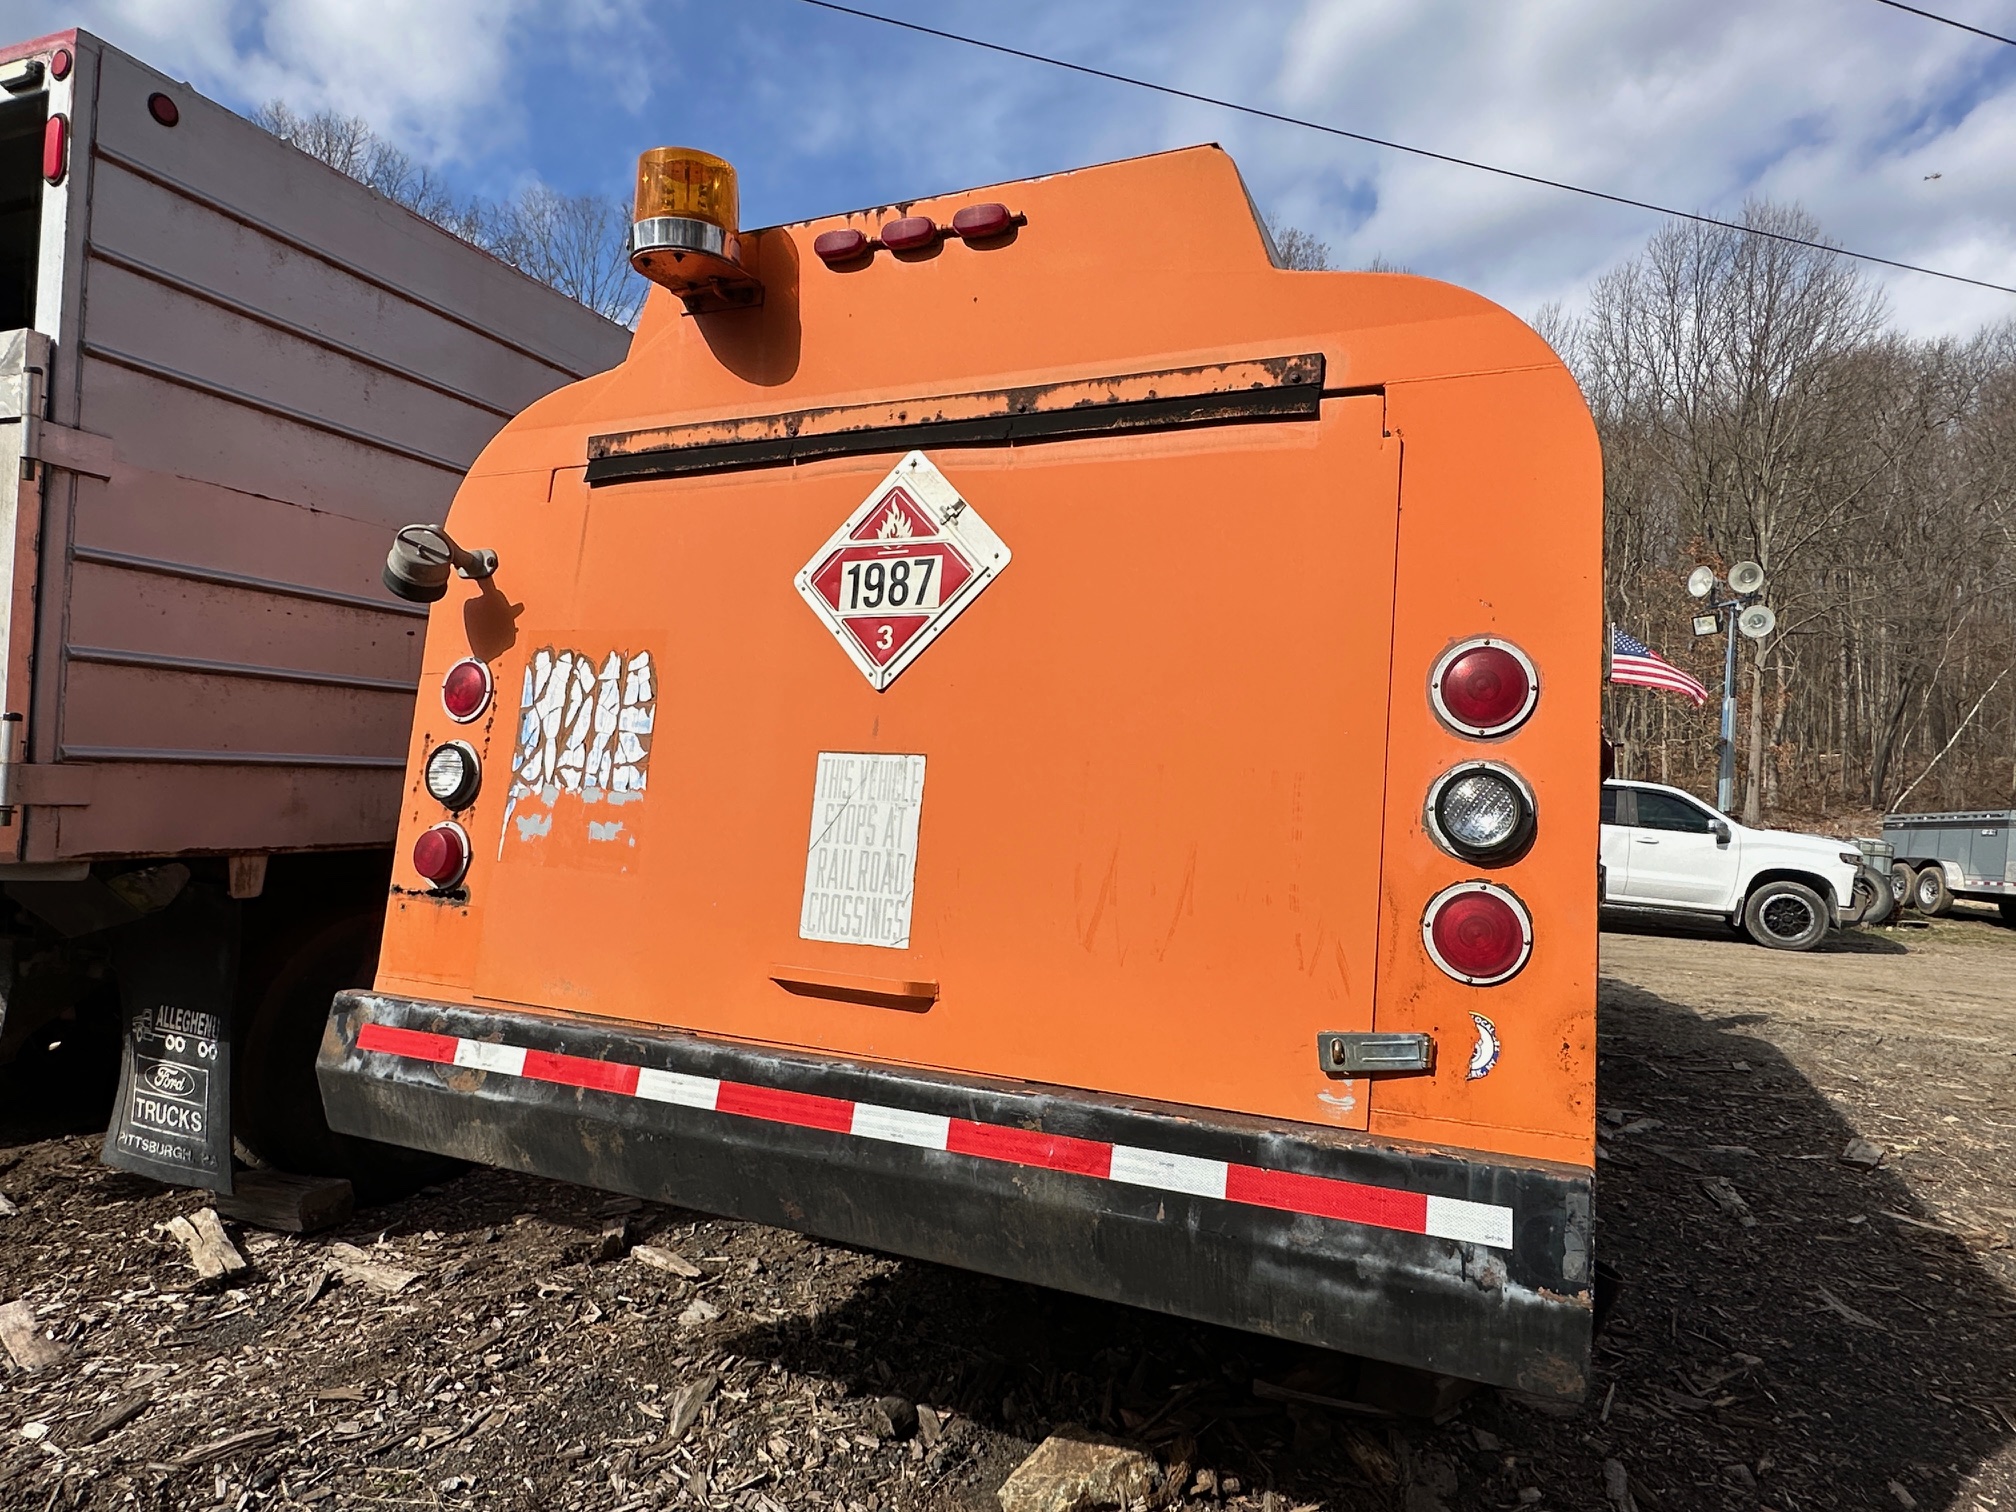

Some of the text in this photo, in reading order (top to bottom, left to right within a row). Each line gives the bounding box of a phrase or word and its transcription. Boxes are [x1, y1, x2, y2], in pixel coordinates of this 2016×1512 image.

[847, 558, 935, 610] 1987
[876, 624, 894, 650] 3
[821, 758, 922, 803] THIS VEHICLE
[823, 803, 907, 848] STOPS AT
[815, 847, 907, 895] RAILROAD
[806, 892, 905, 941] CROSSINGS
[1471, 1014, 1495, 1035] OCAL
[154, 1066, 185, 1092] Ford
[136, 1097, 203, 1133] TRUCKS
